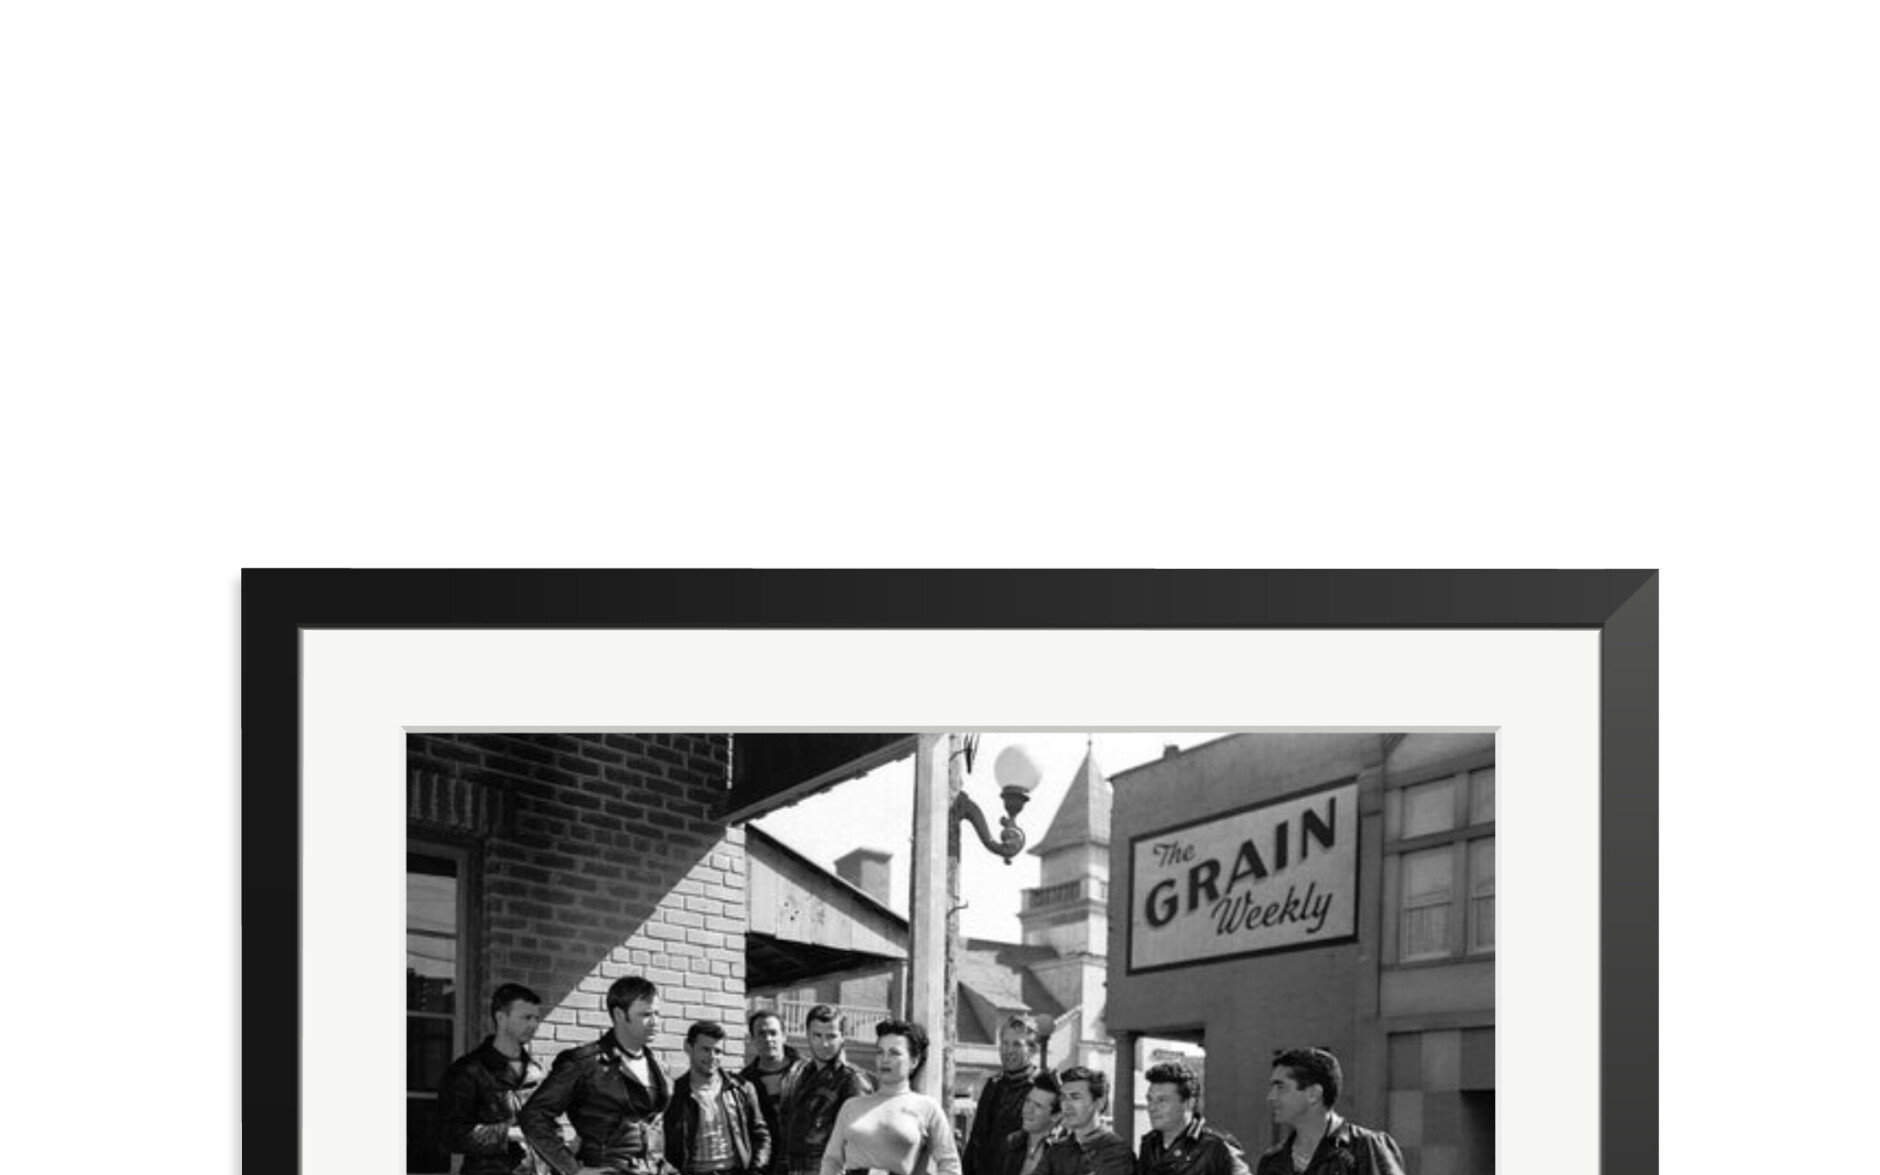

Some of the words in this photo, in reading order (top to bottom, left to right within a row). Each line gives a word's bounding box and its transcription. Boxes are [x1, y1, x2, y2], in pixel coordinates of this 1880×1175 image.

[1146, 797, 1336, 928] GRAIN
[1153, 841, 1195, 868] The
[1211, 881, 1333, 936] Weekly
